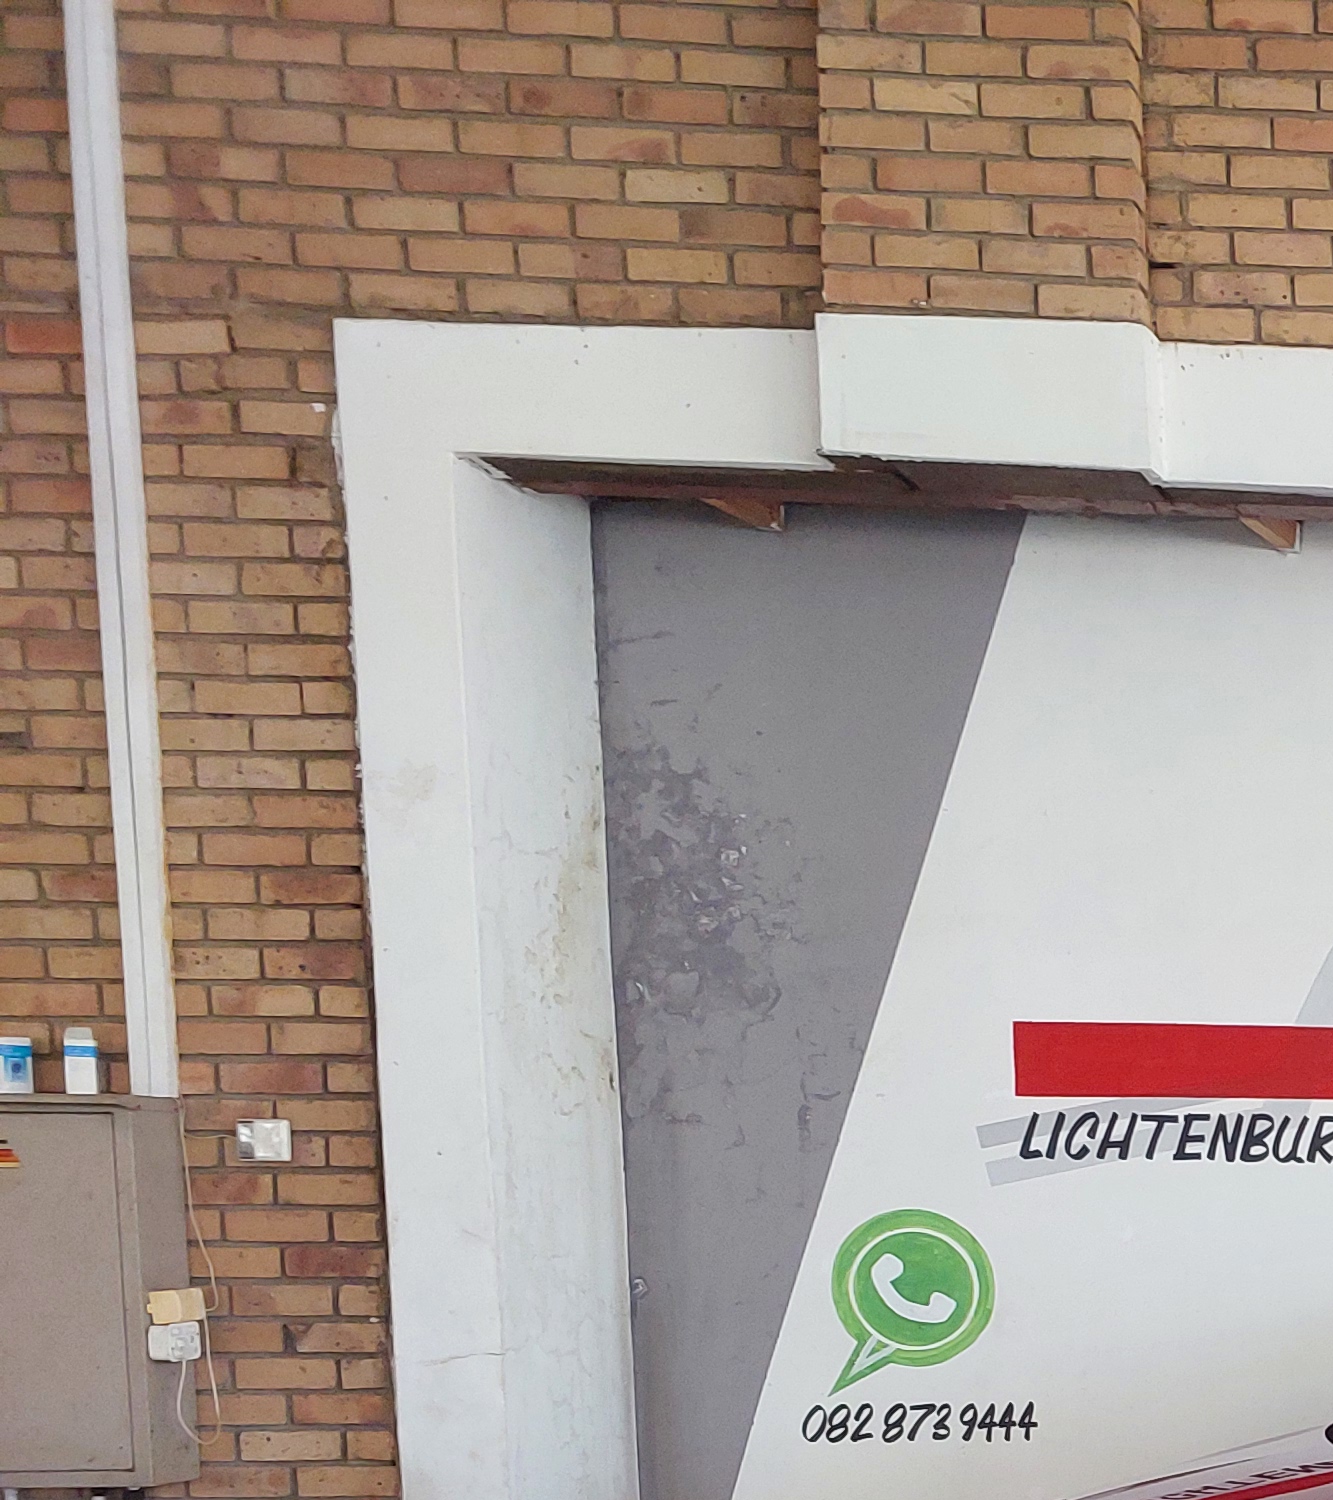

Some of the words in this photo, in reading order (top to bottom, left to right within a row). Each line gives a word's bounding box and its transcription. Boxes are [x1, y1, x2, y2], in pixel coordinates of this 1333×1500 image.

[801, 1403, 874, 1443] 082
[881, 1403, 950, 1443] 873
[959, 1401, 1039, 1443] 9444
